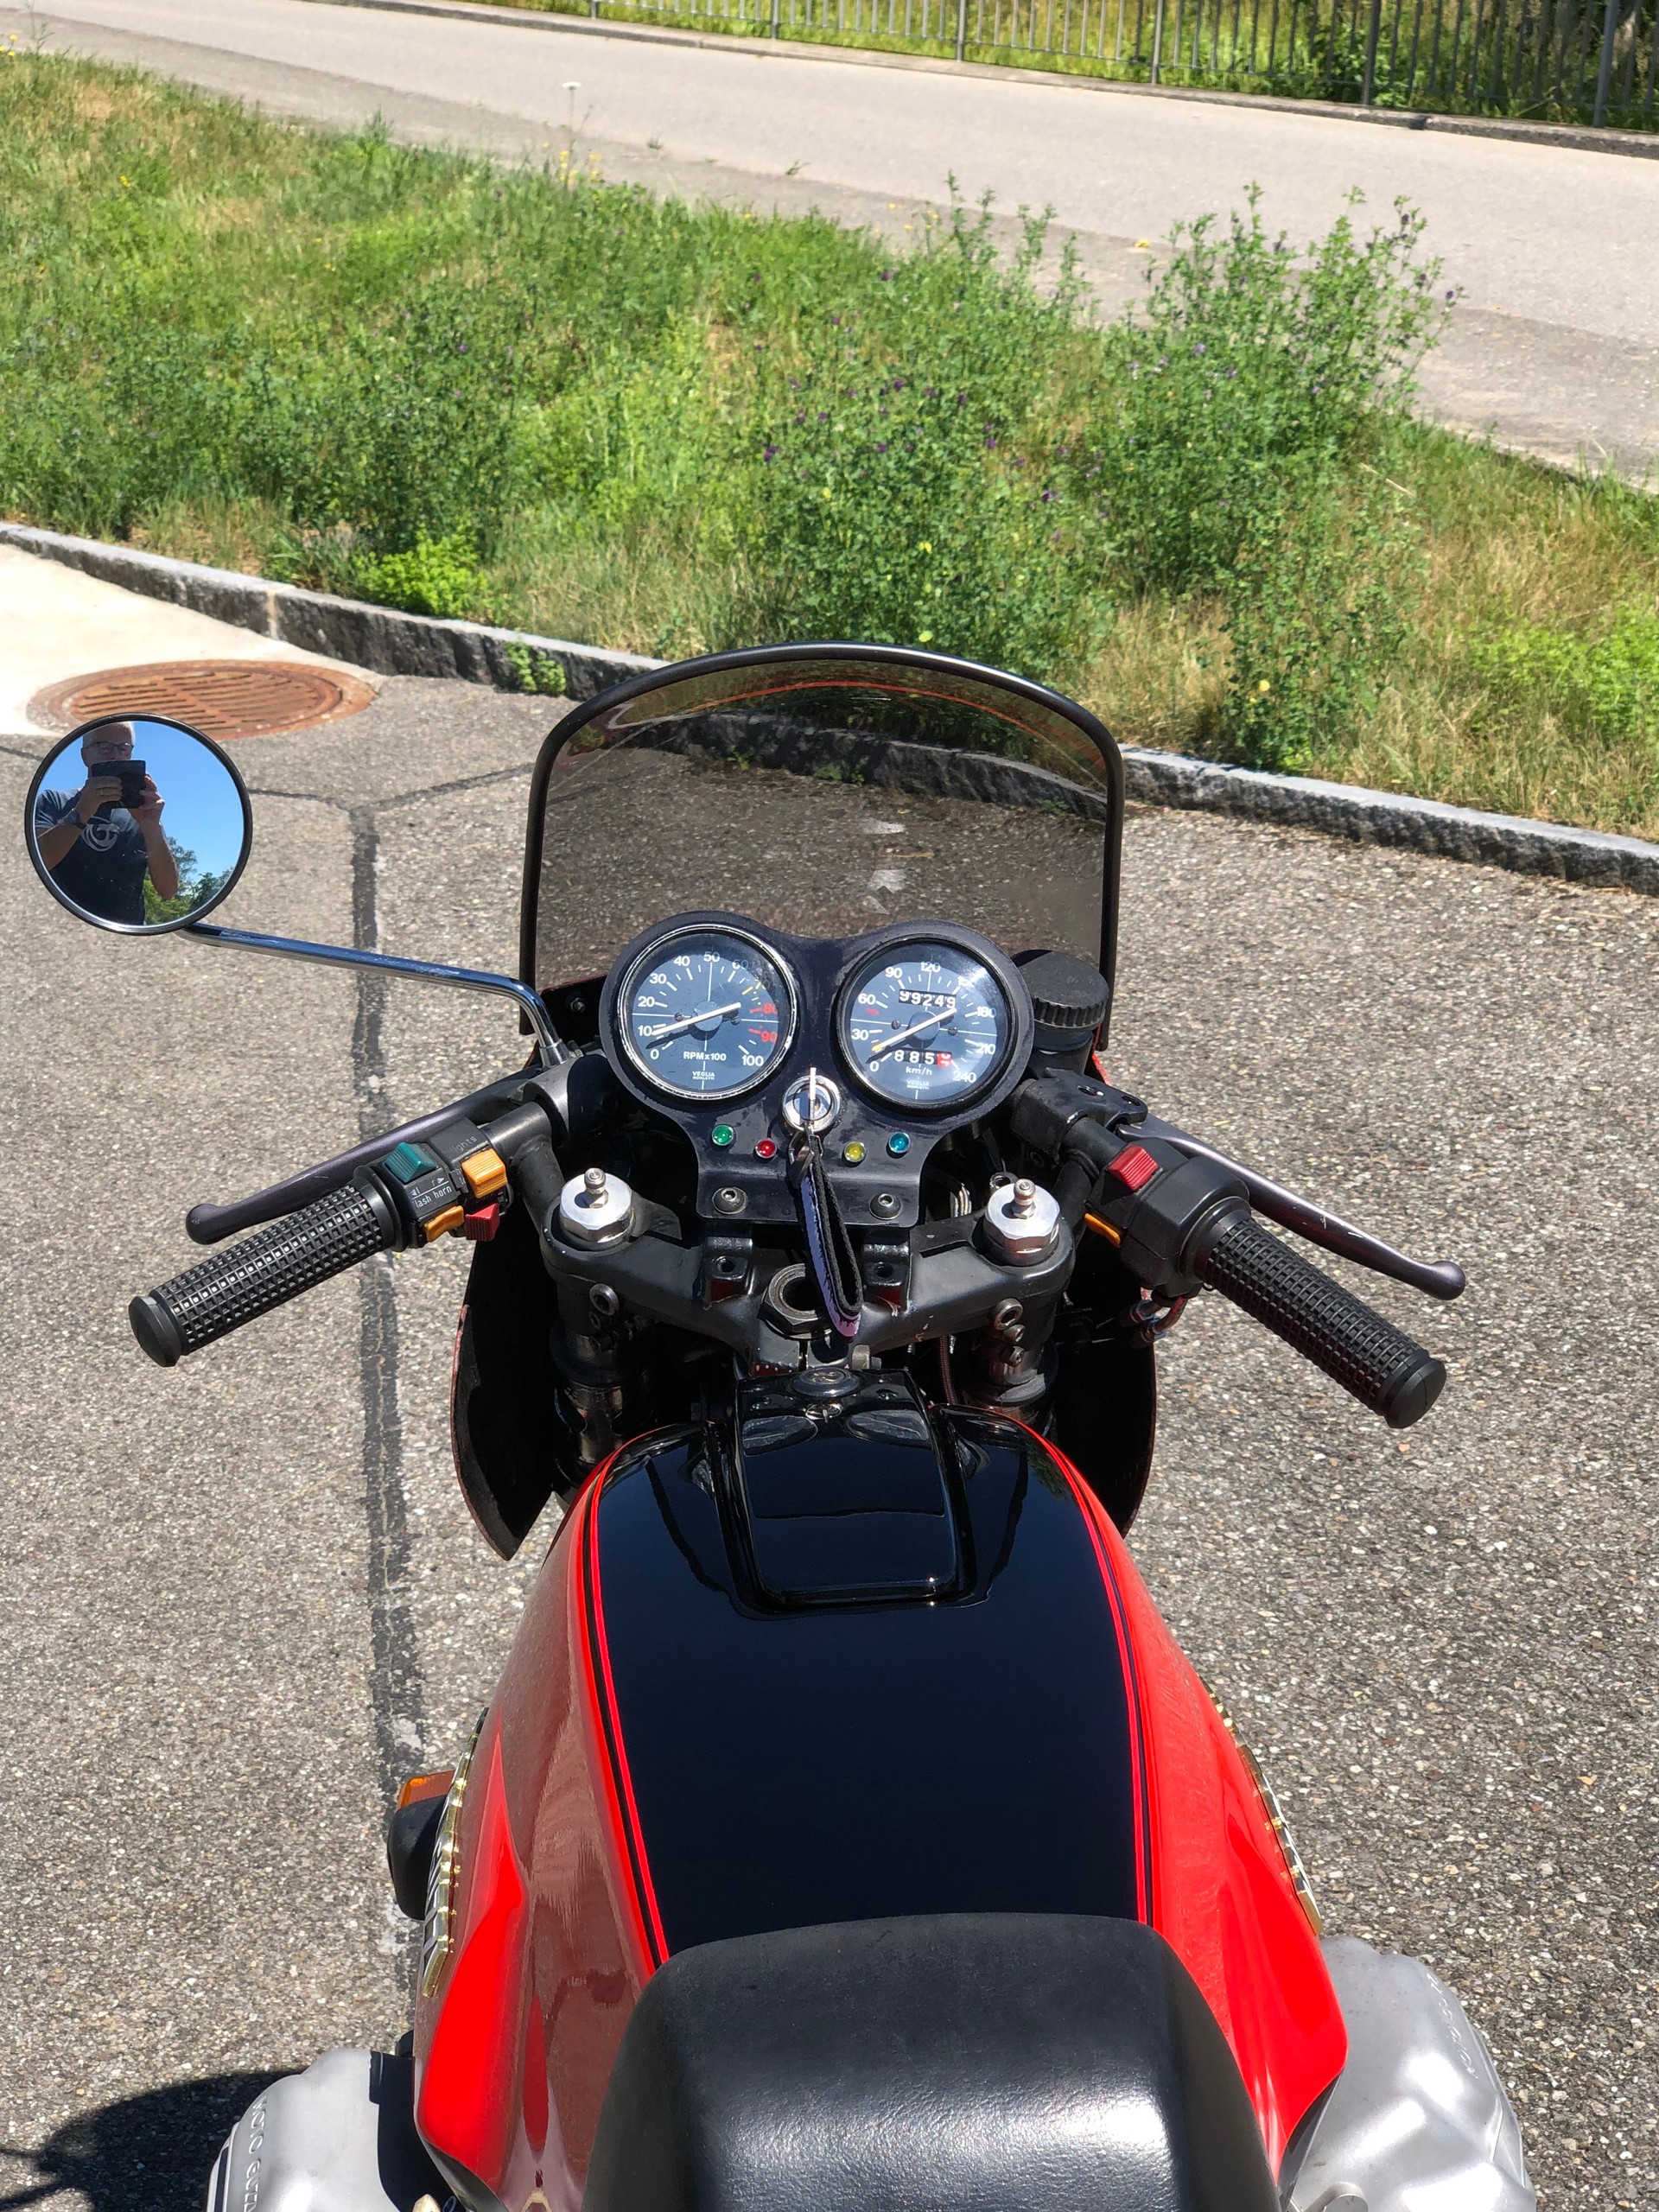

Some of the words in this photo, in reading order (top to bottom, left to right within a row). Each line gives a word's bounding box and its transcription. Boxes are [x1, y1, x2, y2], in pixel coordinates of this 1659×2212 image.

[673, 956, 690, 967] 40
[703, 951, 720, 963] 50
[885, 967, 903, 979] 90
[920, 961, 941, 973] 120
[650, 973, 666, 984] 30
[638, 996, 655, 1007] 20
[857, 994, 876, 1005] 60
[976, 1006, 996, 1019] 180
[638, 1025, 652, 1037] 10
[761, 1031, 778, 1043] 90
[851, 1029, 869, 1041] 30
[650, 1049, 659, 1059] 0
[976, 1043, 995, 1055] 210
[741, 1055, 764, 1067] 100
[869, 1061, 880, 1072] 0
[906, 1065, 932, 1076] km/h
[953, 1071, 977, 1084] 240
[449, 1136, 477, 1152] ights
[413, 1195, 432, 1208] lash
[433, 1185, 453, 1198] horn
